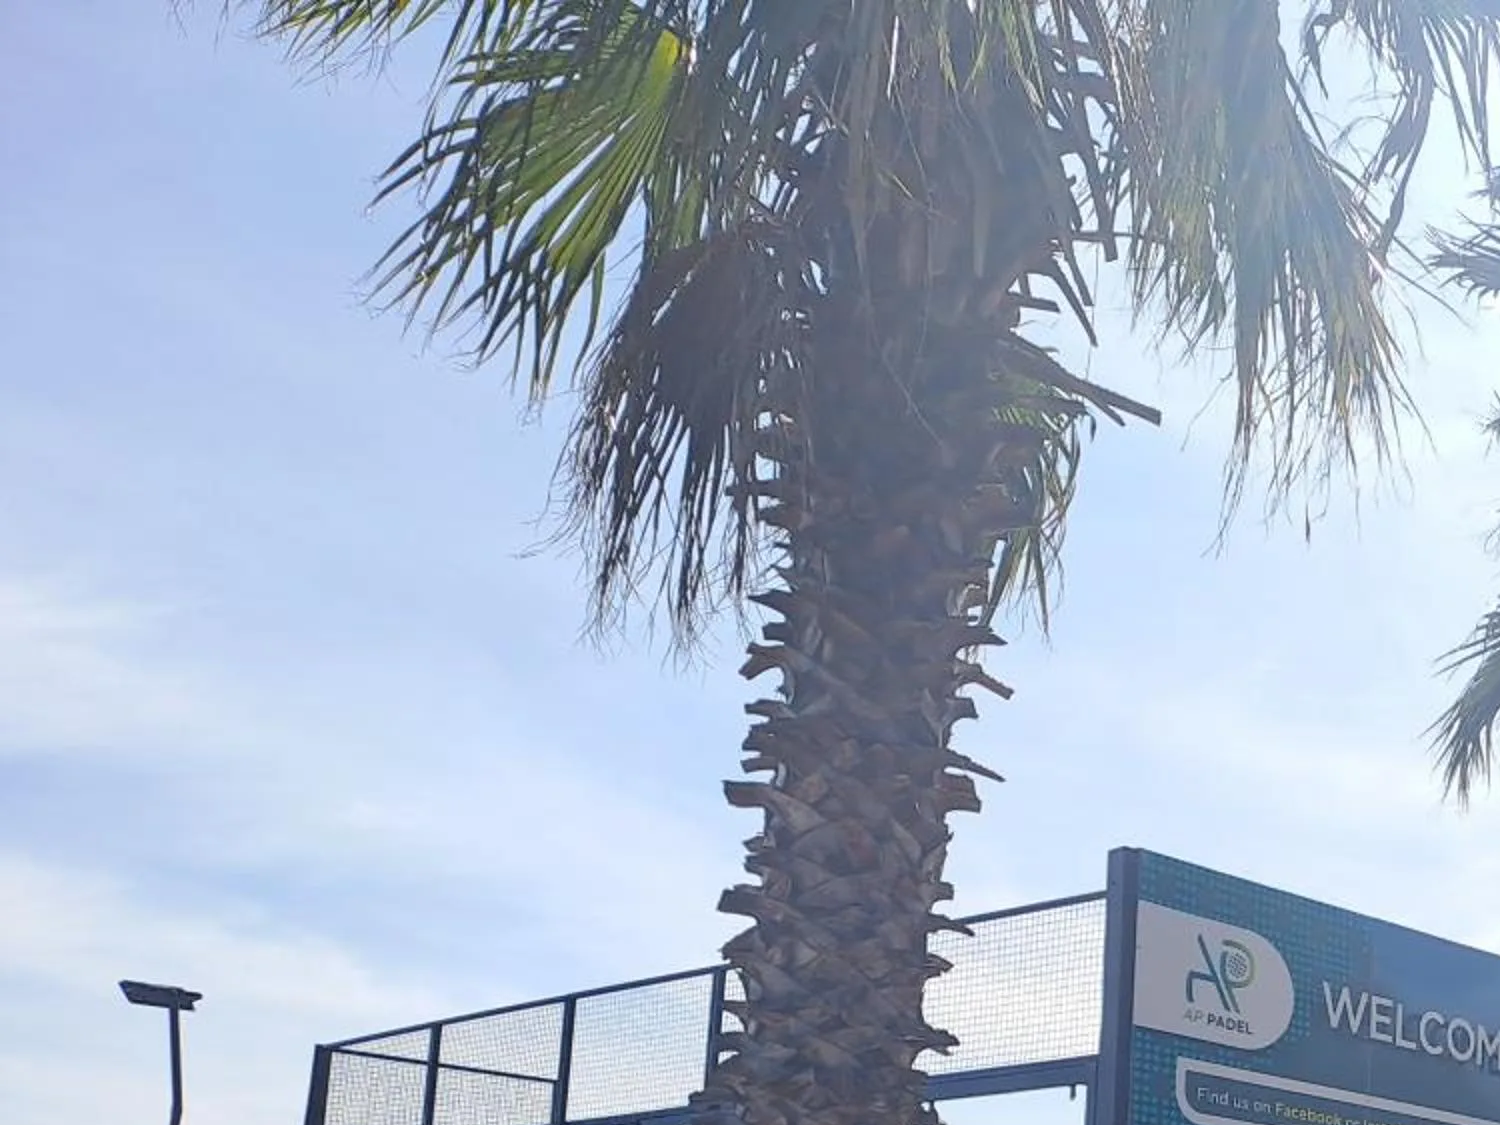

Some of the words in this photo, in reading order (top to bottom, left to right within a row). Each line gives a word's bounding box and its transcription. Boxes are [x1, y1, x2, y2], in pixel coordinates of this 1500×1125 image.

[1183, 1008, 1204, 1023] AP
[1206, 1012, 1255, 1035] PADEL
[1197, 1086, 1229, 1105] Find
[1233, 1096, 1249, 1110] us
[1253, 1100, 1271, 1113] on
